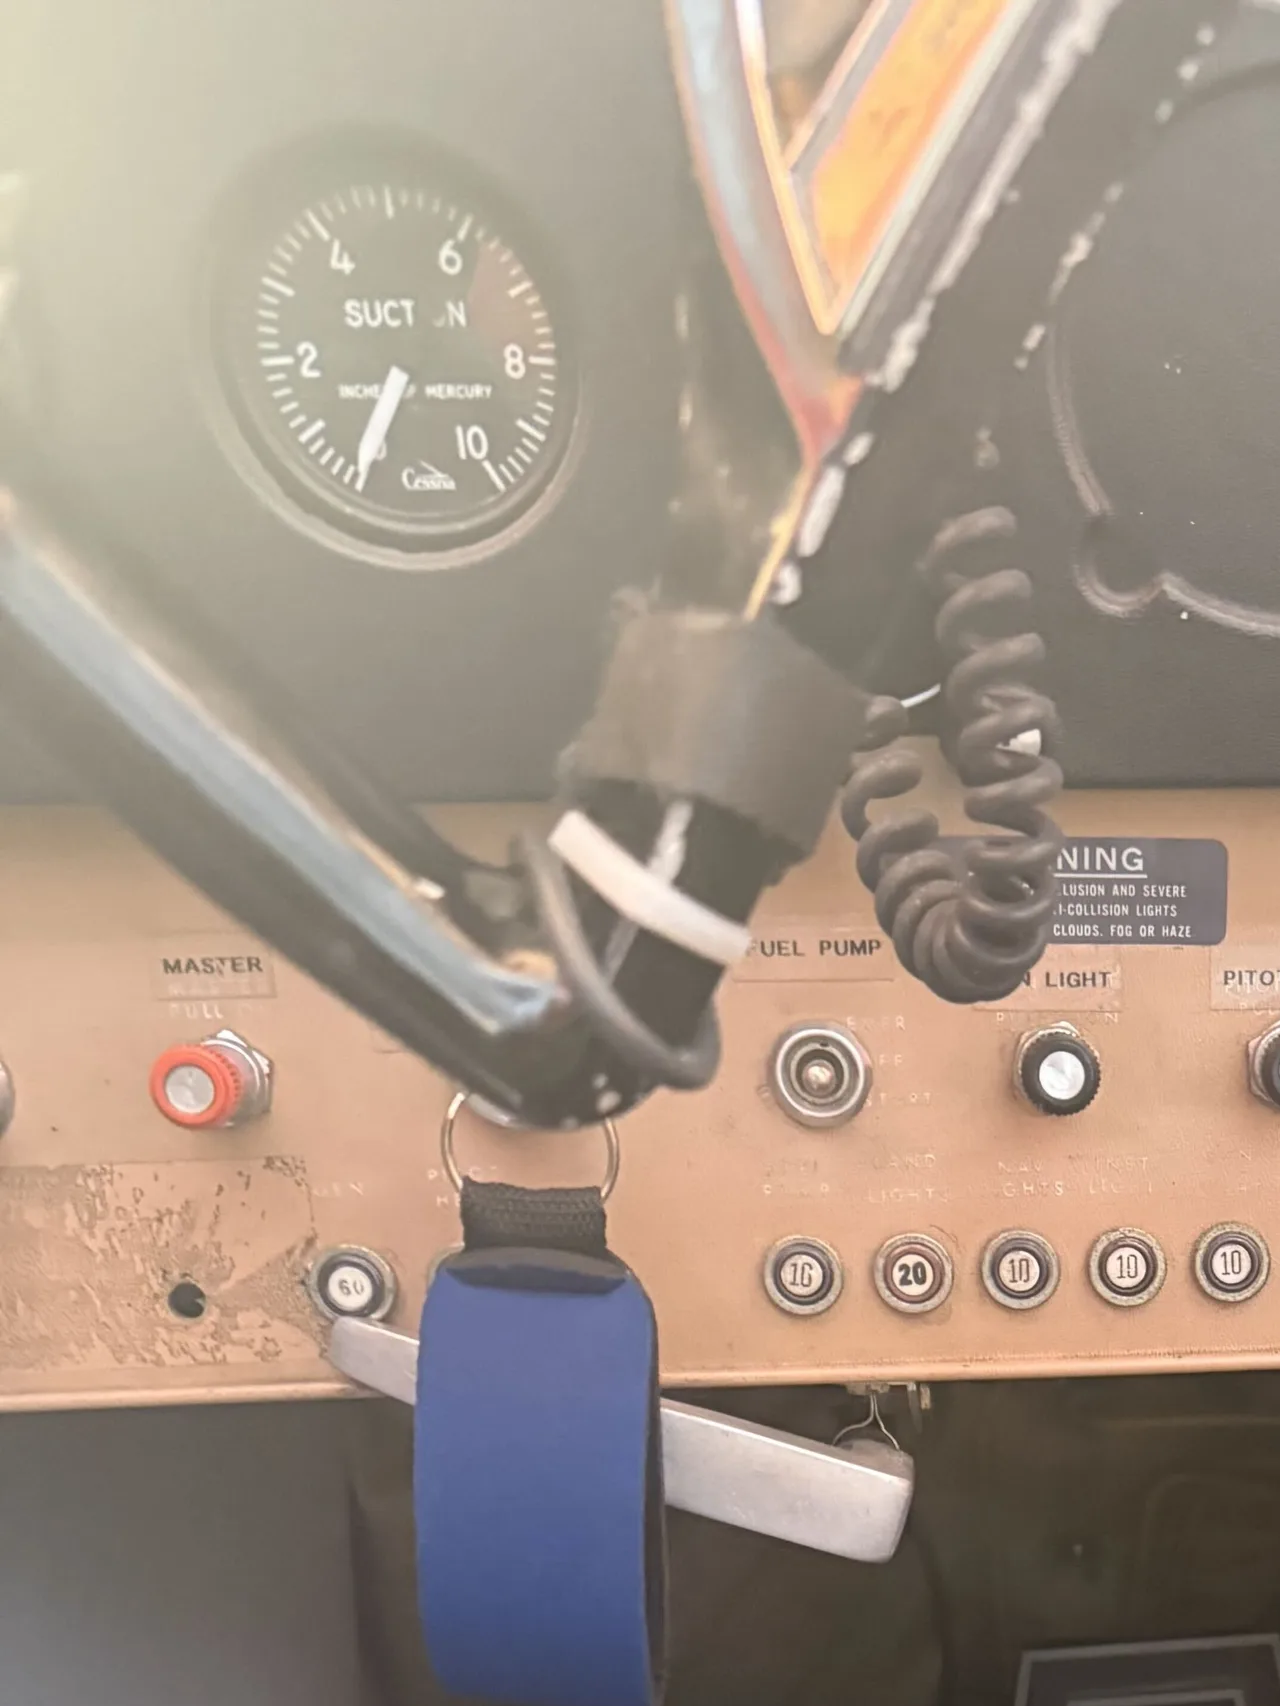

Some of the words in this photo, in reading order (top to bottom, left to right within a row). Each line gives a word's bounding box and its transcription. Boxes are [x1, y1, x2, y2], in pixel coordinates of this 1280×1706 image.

[330, 240, 356, 275] 4
[438, 240, 463, 275] 6
[344, 298, 467, 328] SUCTN
[296, 341, 321, 377] 2
[503, 343, 527, 379] 8
[338, 383, 386, 399] INCHE
[425, 383, 493, 400] MERCURY
[455, 424, 489, 460] 10
[401, 465, 457, 490] Cessna
[1056, 845, 1145, 872] NING
[1058, 884, 1105, 897] LUSION
[1112, 884, 1137, 897] AND
[1143, 885, 1187, 898] SEVERE
[1053, 903, 1130, 917] I-COLLISION
[1136, 904, 1178, 917] LIGHTS
[1110, 925, 1133, 937] FOG
[1139, 925, 1155, 937] OR
[1162, 925, 1192, 938] HAZE
[819, 939, 882, 957] PUMP
[162, 956, 264, 975] MASTER
[1045, 971, 1112, 988] LIGHT
[897, 1260, 927, 1286] 20
[1007, 1257, 1030, 1283] 10
[1115, 1253, 1138, 1279] 10
[1220, 1249, 1242, 1275] 10
[337, 1278, 365, 1296] 60
